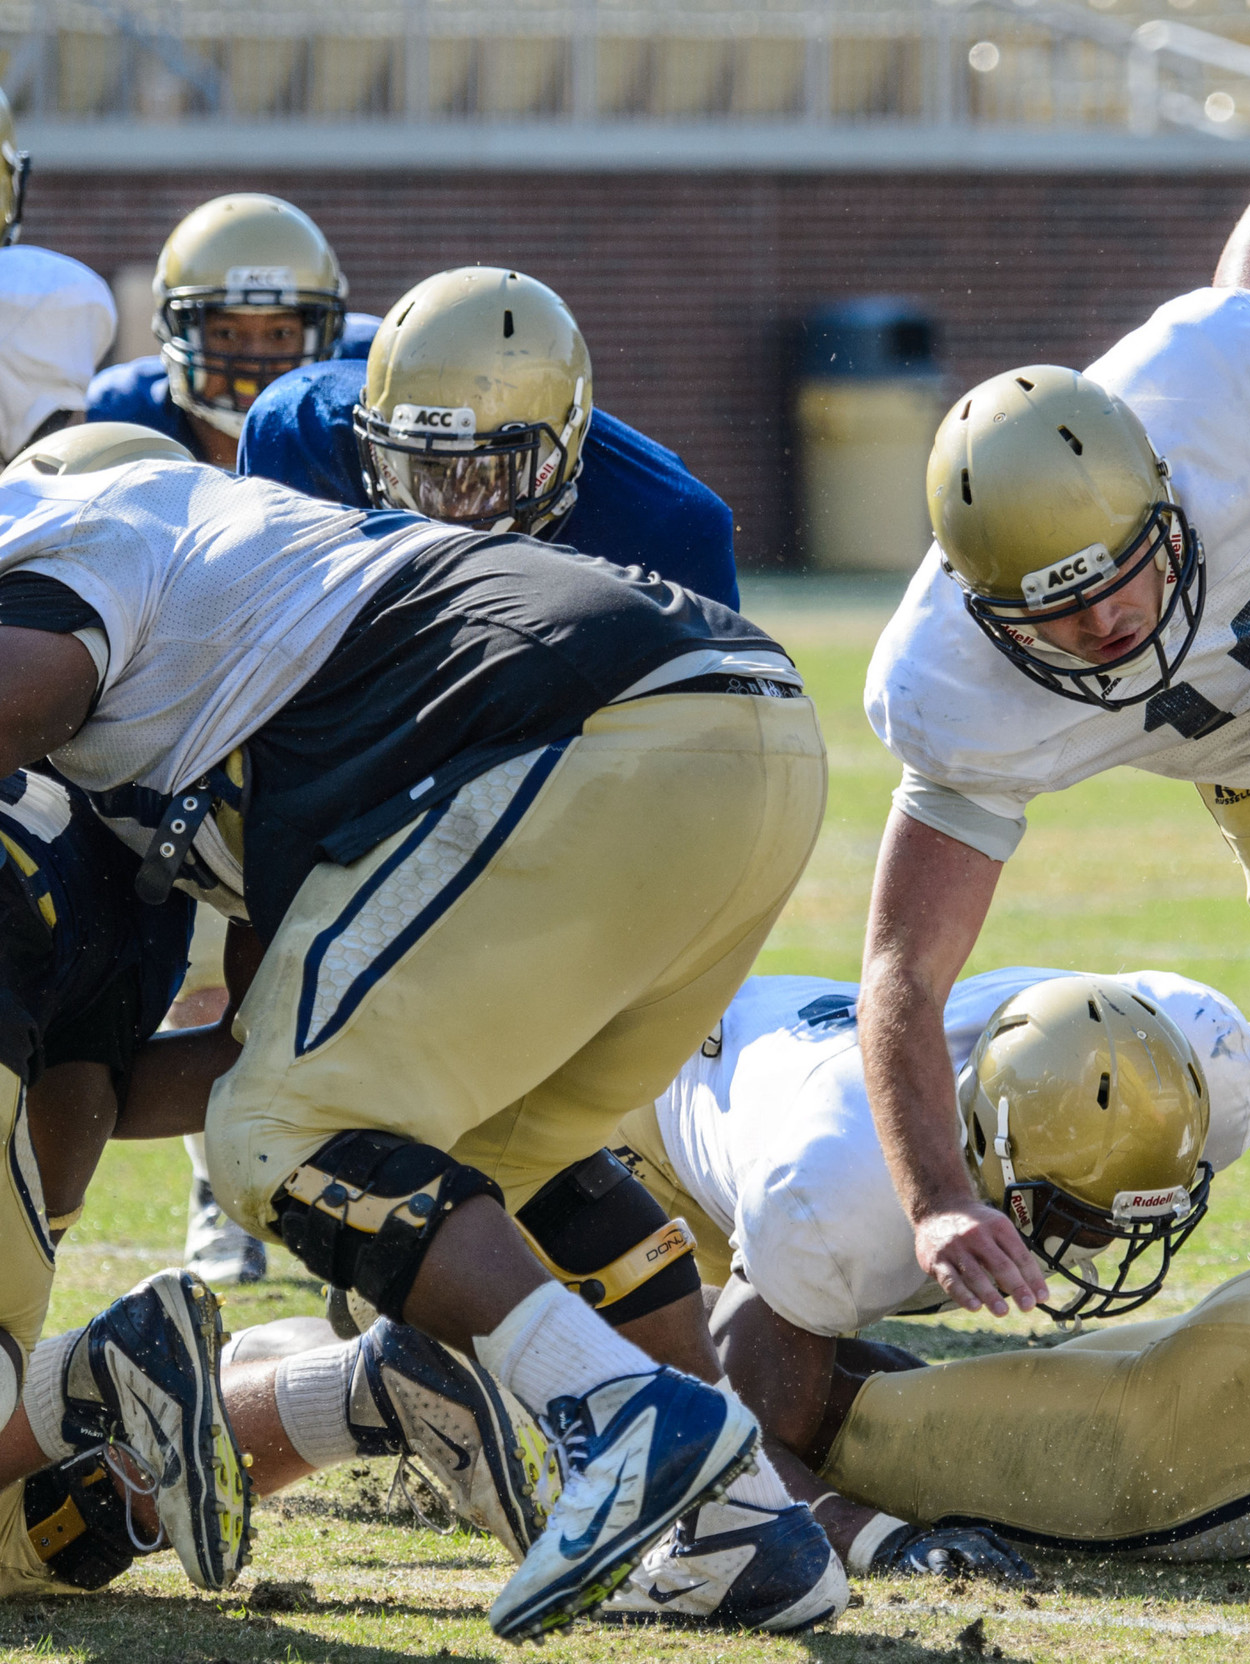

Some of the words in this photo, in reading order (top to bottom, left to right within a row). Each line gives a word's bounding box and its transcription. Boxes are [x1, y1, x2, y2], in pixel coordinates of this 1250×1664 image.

[414, 410, 452, 427] ACC
[535, 464, 554, 491] dell
[1047, 557, 1088, 588] ACC
[1011, 1194, 1031, 1228] Riddell
[1132, 1192, 1175, 1208] Riddell
